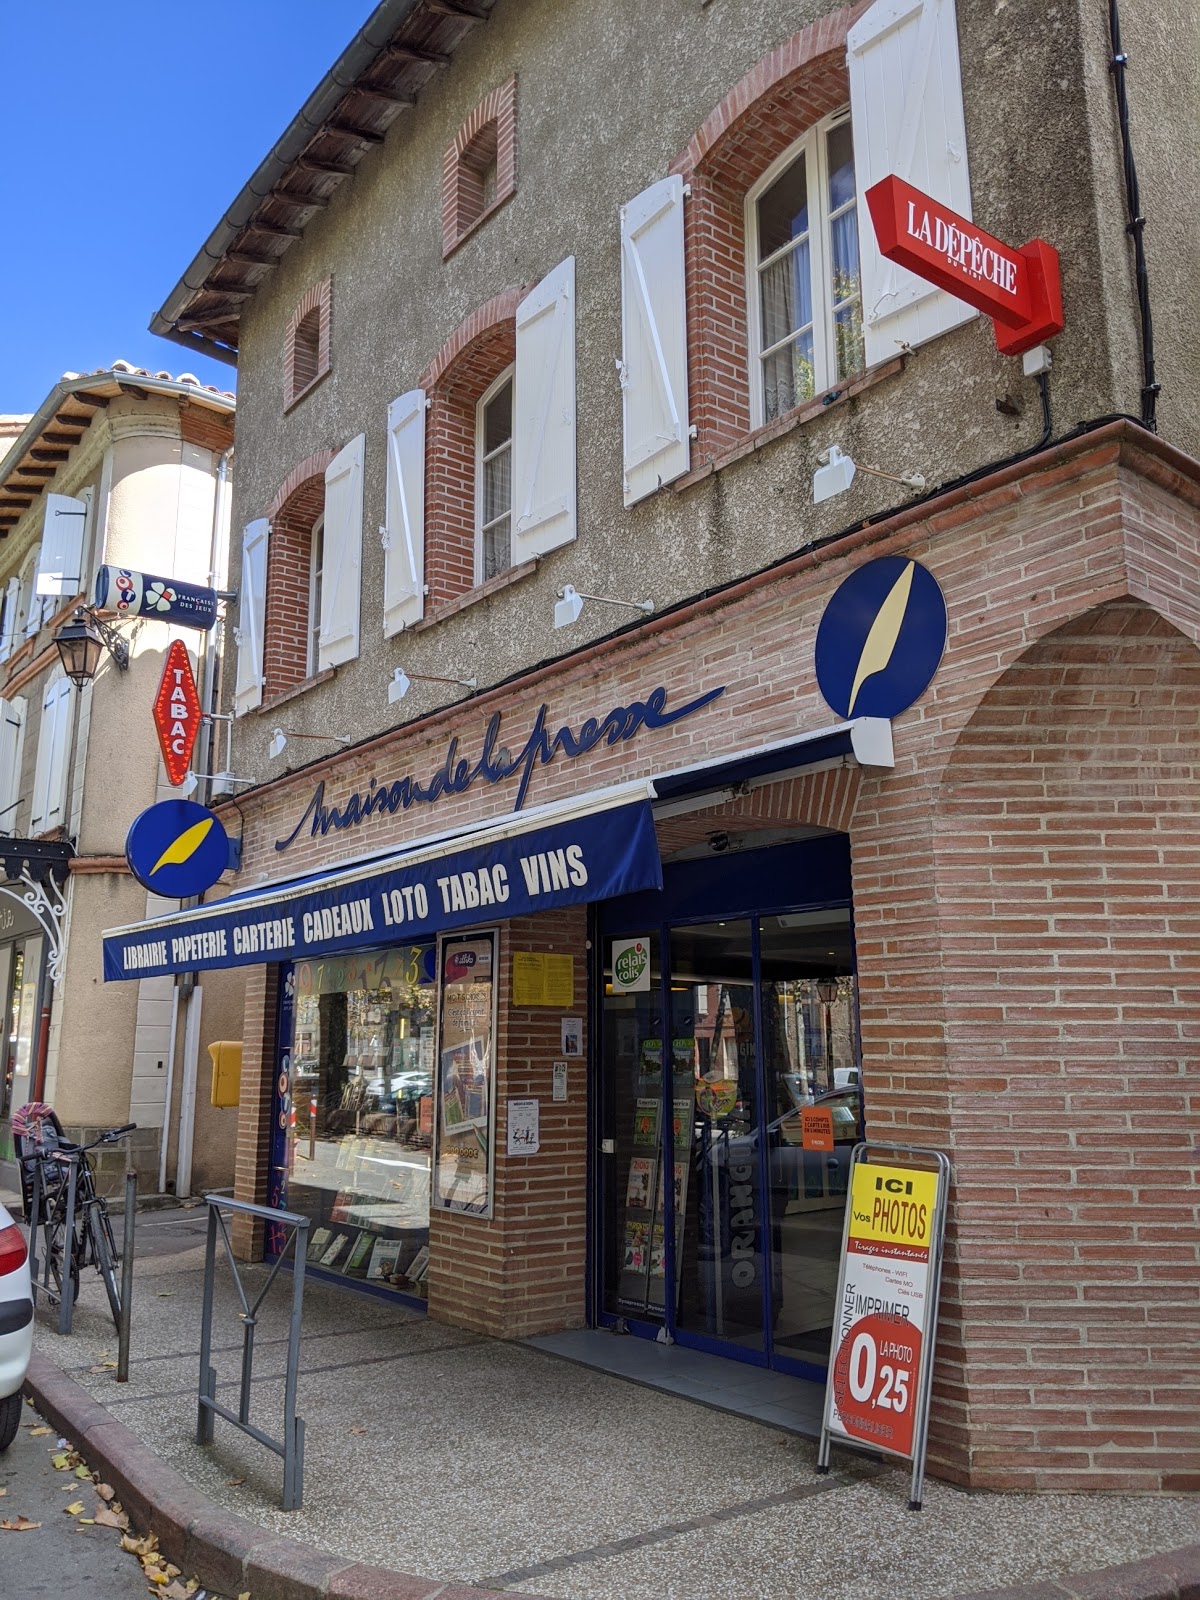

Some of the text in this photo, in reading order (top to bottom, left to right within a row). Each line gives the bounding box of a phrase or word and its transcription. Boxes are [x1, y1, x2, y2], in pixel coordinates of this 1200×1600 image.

[907, 201, 1017, 295] LA DÉPÊCHE
[195, 605, 212, 613] JEUX
[170, 668, 188, 755] TABAC
[123, 844, 588, 970] LIBRAIRIE PAPETERIE CARTERIE CADEAUX LOTO TABAC VINS
[617, 953, 647, 970] relais
[619, 967, 639, 980] colis
[875, 1177, 913, 1195] ICI
[853, 1197, 927, 1240] Vos PHOTOS
[854, 1241, 879, 1255] Tirages
[862, 1263, 891, 1274] Téléphones
[885, 1276, 902, 1286] Cartes
[897, 1288, 923, 1299] Clés USB
[855, 1294, 910, 1327] IMPRIMER
[880, 1339, 913, 1364] LA PHOTO
